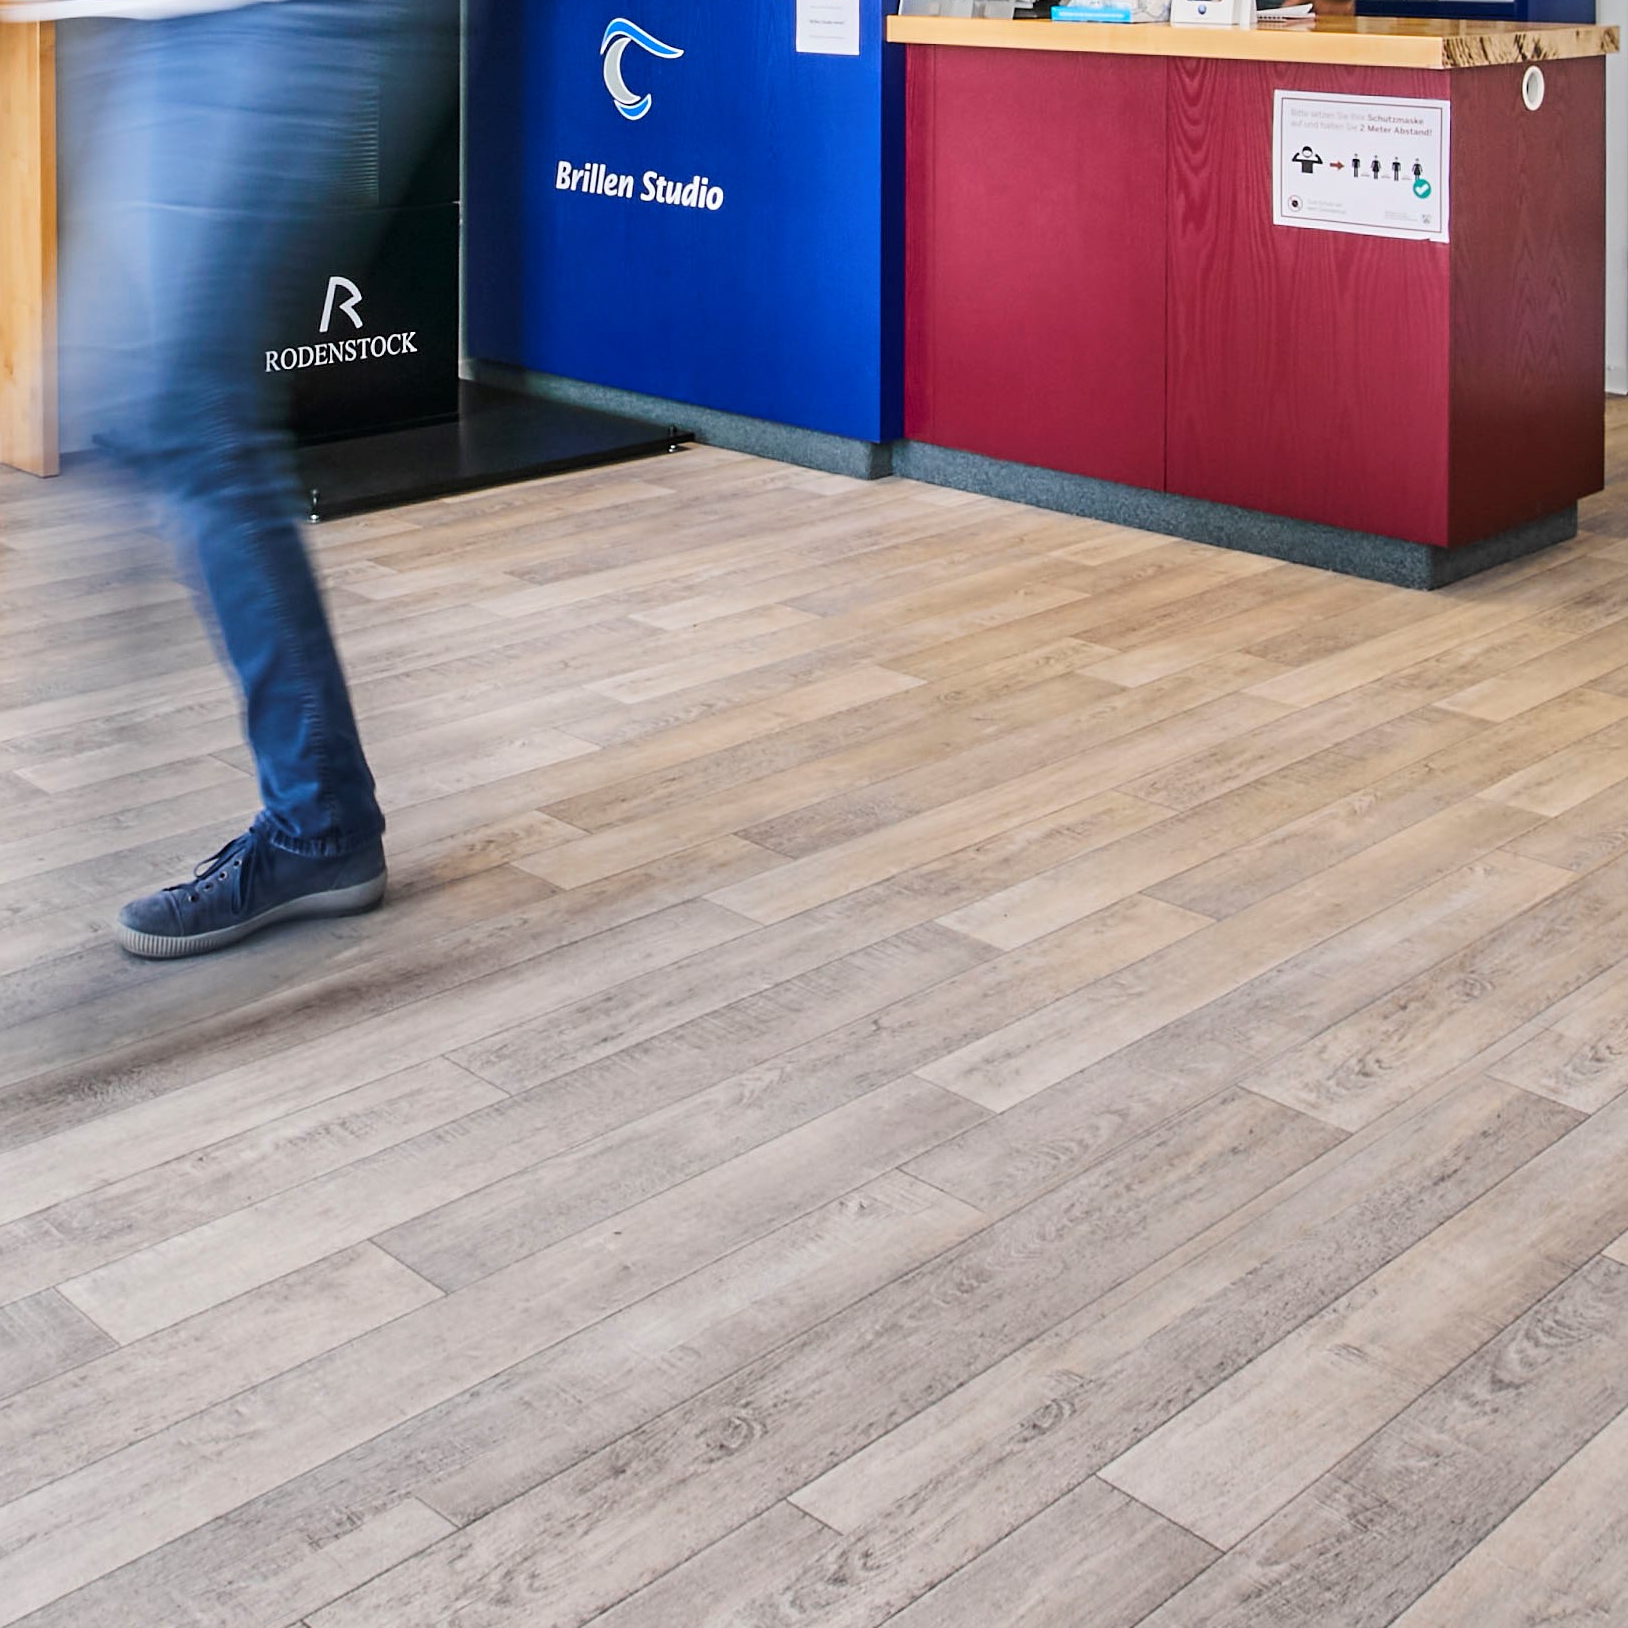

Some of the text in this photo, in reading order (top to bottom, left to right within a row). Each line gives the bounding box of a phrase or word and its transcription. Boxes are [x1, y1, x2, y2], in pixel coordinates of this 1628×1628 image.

[1367, 113, 1424, 124] Schutzmaske
[1367, 125, 1392, 133] Meter
[1394, 126, 1432, 137] Abstand!
[555, 160, 724, 211] Brillen Studio
[265, 331, 418, 373] RODENSTOCK
